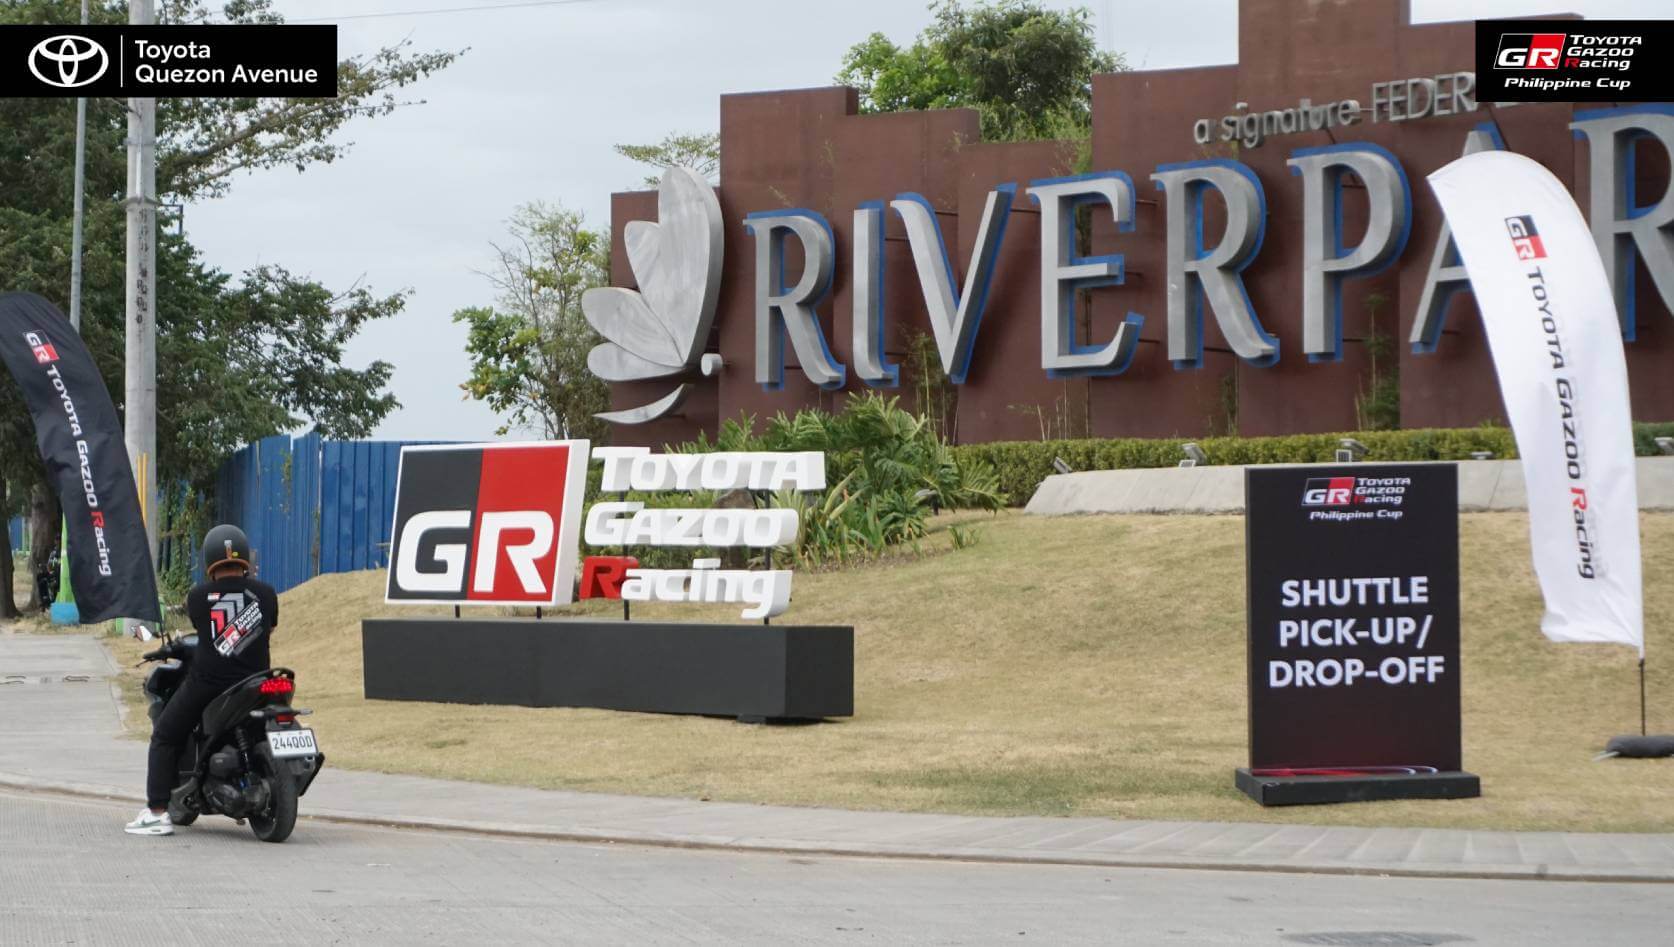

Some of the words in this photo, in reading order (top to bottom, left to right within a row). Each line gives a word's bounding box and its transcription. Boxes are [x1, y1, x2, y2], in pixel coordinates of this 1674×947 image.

[1194, 118, 1212, 144] a
[1221, 98, 1361, 149] signature
[1371, 71, 1479, 123] FEDER
[1506, 216, 1536, 260] GR
[25, 331, 50, 363] GR
[1527, 265, 1565, 369] TOYOTA
[1556, 378, 1581, 481] GAZOO
[1571, 486, 1596, 580] Racing
[46, 364, 82, 437] TOYOTA
[76, 440, 98, 508] GAZOO
[90, 511, 112, 577] Racing
[591, 446, 826, 492] TOYOTA
[1357, 477, 1411, 486] TOYOTA
[1305, 488, 1351, 504] GR
[1353, 495, 1403, 505] Racing
[1355, 486, 1405, 495] GAZOO
[584, 501, 799, 547] GAZOO
[1310, 510, 1375, 521] Philippine
[1376, 509, 1404, 520] Cup
[396, 510, 554, 594] GR
[579, 556, 793, 619] Racing
[1281, 576, 1429, 607] SHUTTLE
[1279, 614, 1433, 649] PICK-UP/
[1269, 655, 1445, 688] DROP-OFF
